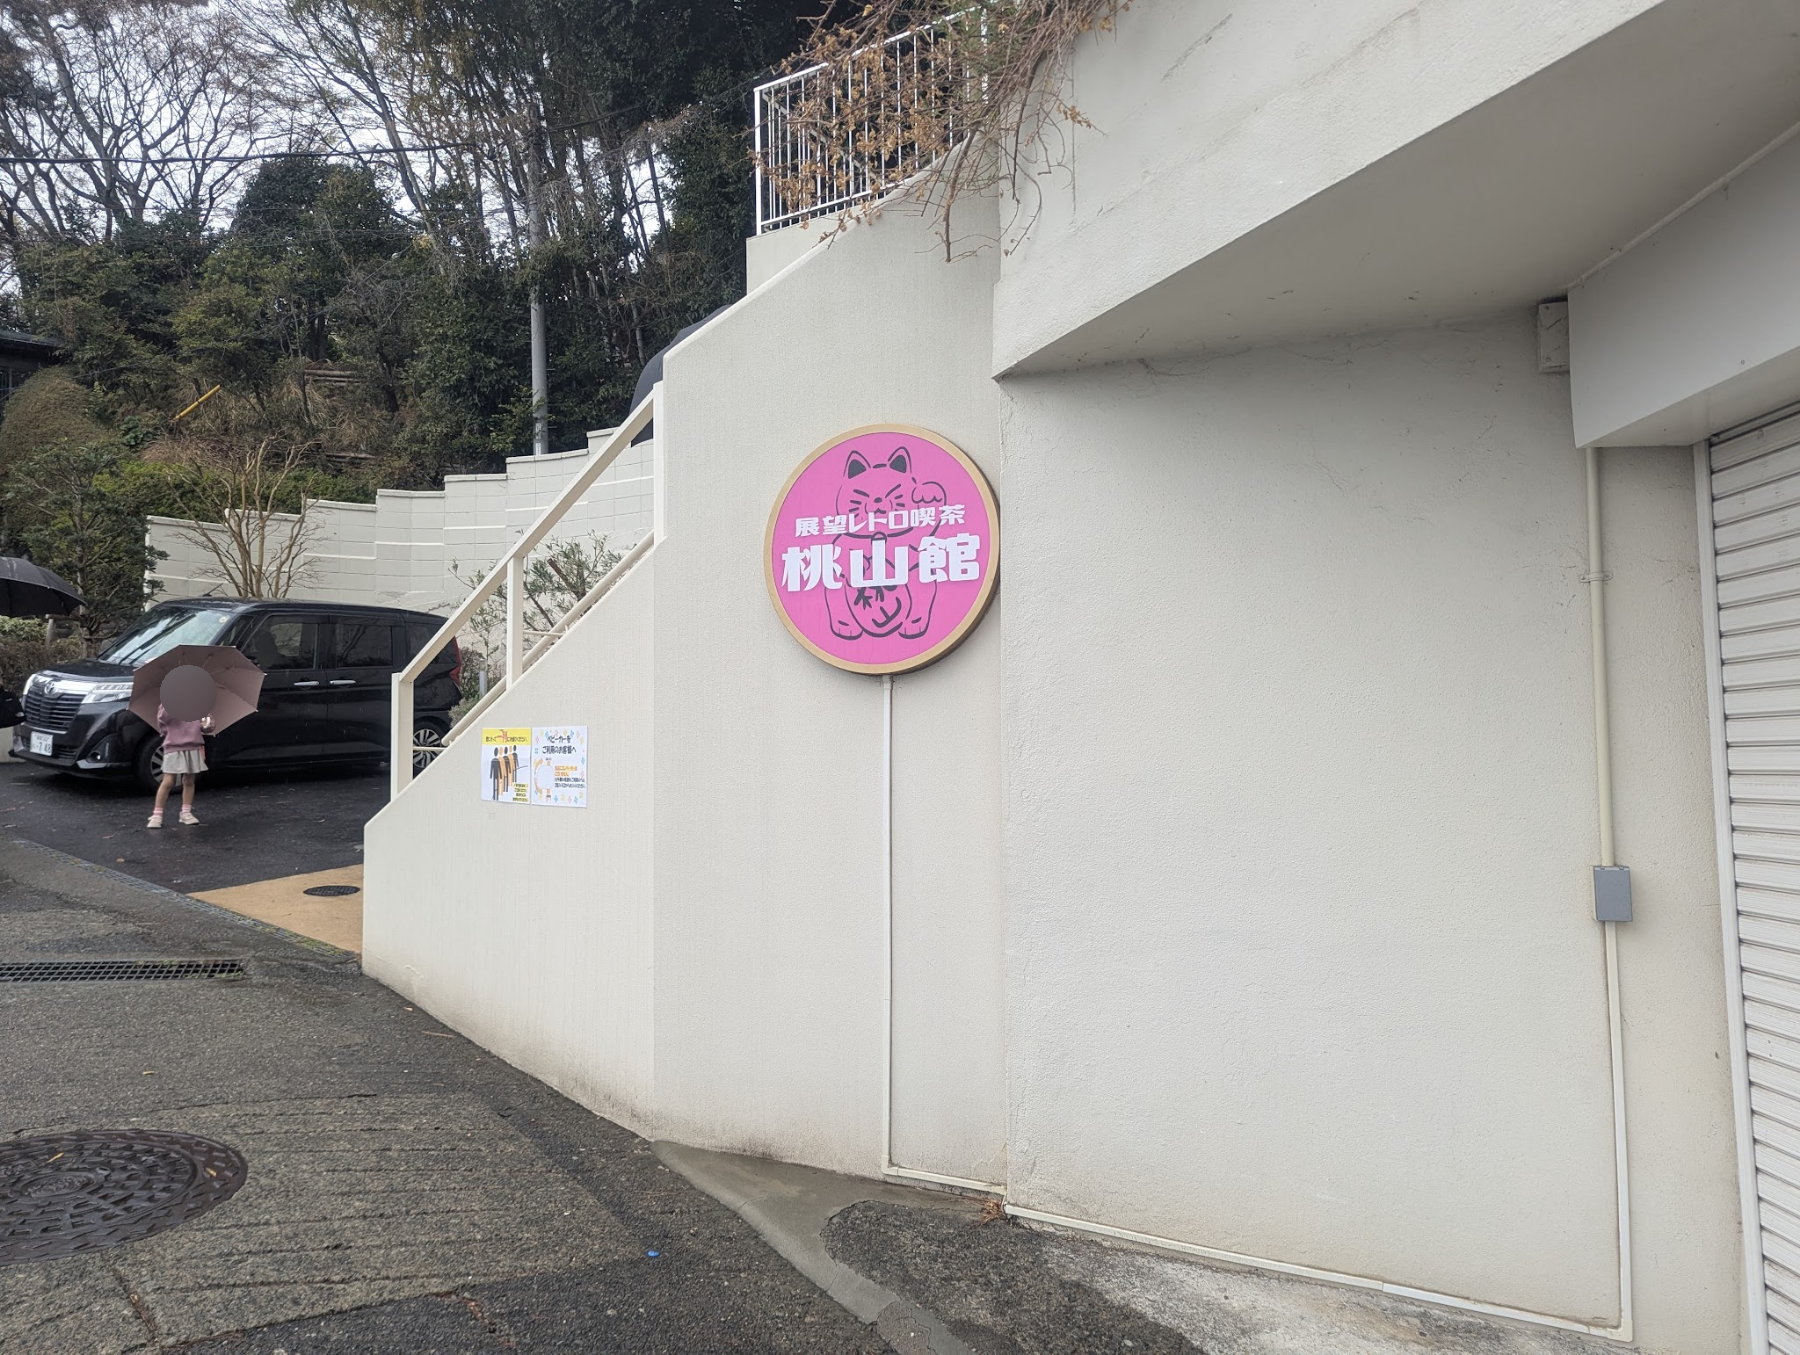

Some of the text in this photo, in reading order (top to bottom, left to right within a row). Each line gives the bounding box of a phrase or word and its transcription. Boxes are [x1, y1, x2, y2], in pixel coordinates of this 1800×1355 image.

[795, 504, 966, 538] 展望レトロ喫茶
[781, 532, 981, 592] 桃山館
[542, 745, 577, 755] ご利用のお客様へ
[547, 735, 572, 744] ベビーカーを
